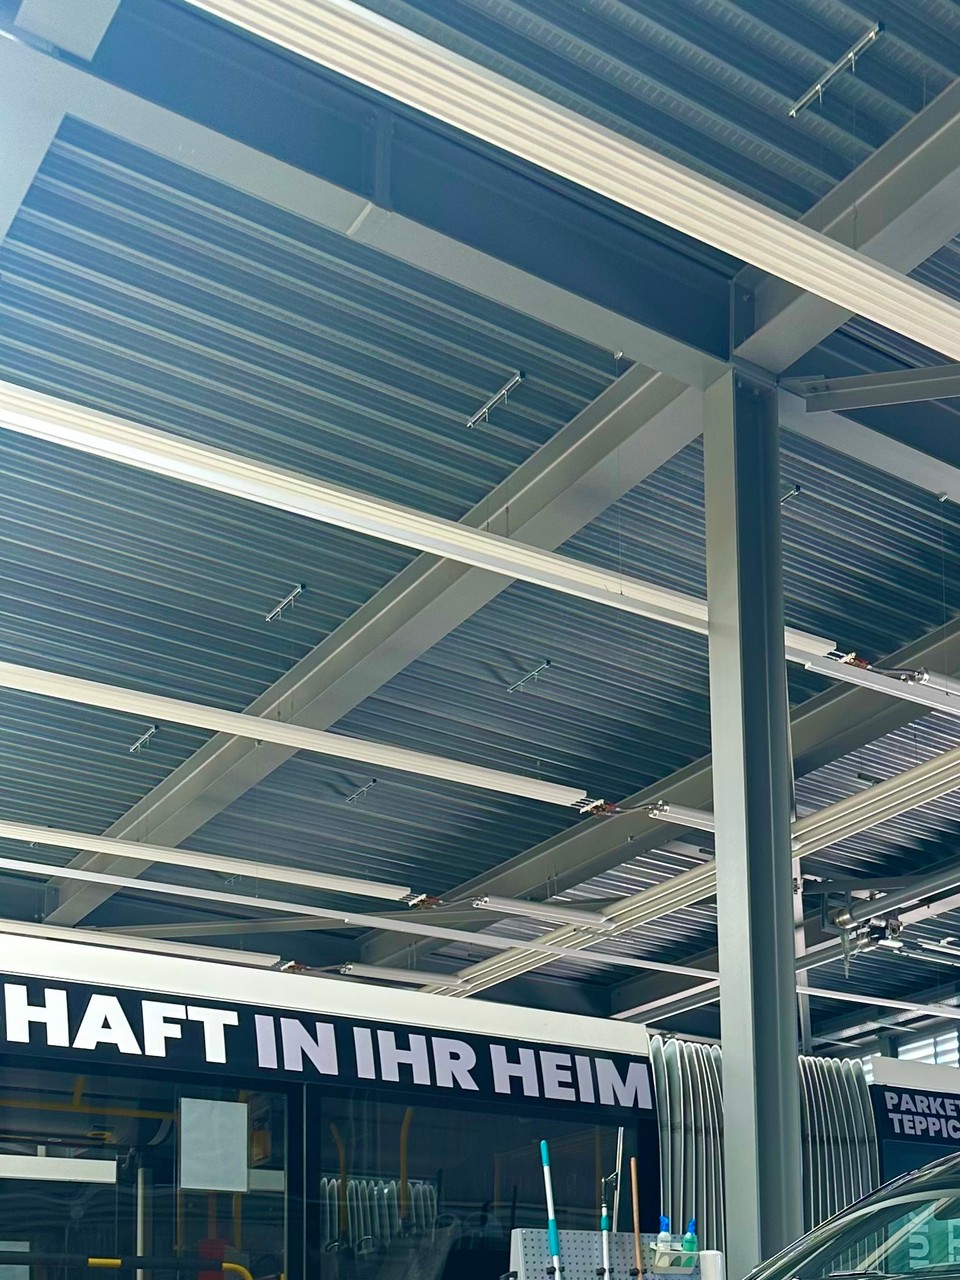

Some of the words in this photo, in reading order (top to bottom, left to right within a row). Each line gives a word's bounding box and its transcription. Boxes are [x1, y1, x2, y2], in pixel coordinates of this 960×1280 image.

[4, 983, 239, 1064] HAFT
[254, 1014, 339, 1076] IN
[352, 1026, 480, 1091] IHR
[489, 1044, 653, 1110] HEIM
